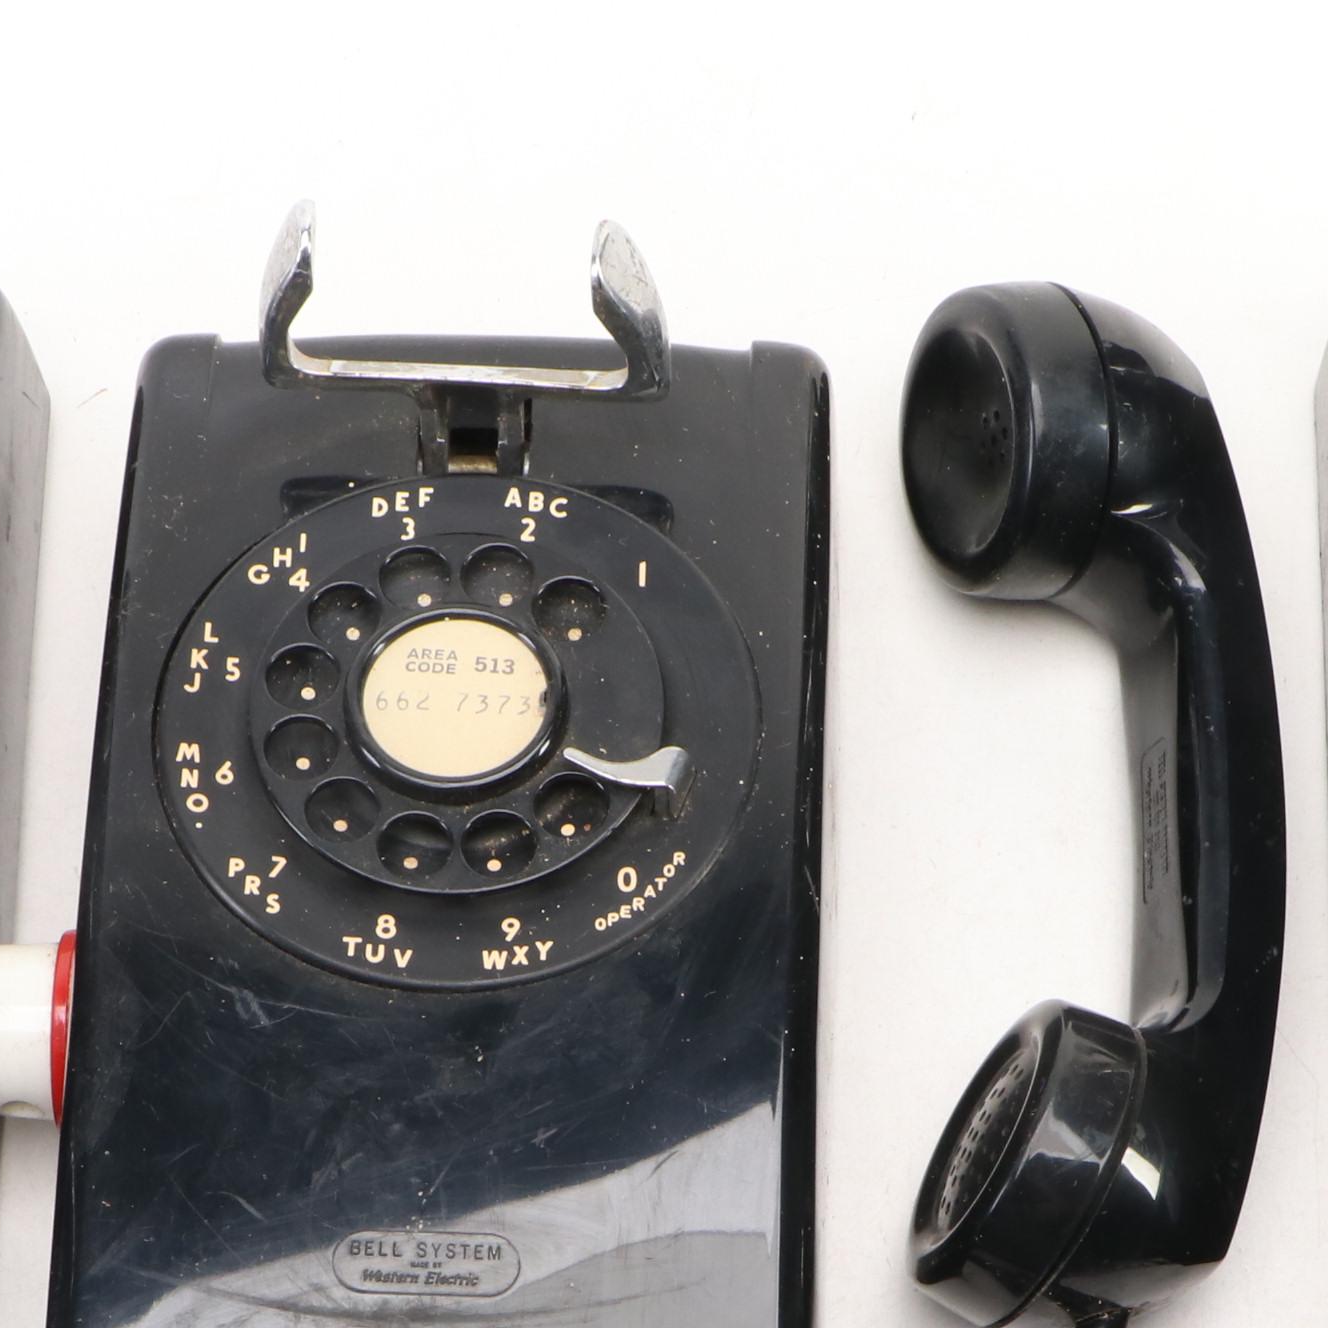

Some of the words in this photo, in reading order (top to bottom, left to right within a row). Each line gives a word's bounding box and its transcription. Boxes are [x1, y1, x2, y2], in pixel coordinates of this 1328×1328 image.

[371, 486, 435, 518] DEF
[503, 486, 569, 518] ABC
[400, 516, 416, 541] 3
[519, 517, 537, 543] 2
[248, 532, 309, 584] GHI
[287, 566, 310, 592] 4
[405, 661, 457, 675] CODE
[406, 648, 458, 662] AREA
[474, 656, 516, 675] 513
[224, 656, 241, 682] 5
[375, 690, 431, 711] 662
[455, 692, 532, 716] 7373
[214, 760, 235, 786] 6
[268, 855, 288, 879] 7
[227, 857, 281, 914] PRS
[594, 851, 686, 932] OPERATOR
[375, 914, 397, 940] 8
[500, 917, 521, 942] 9
[342, 935, 414, 969] TUV
[481, 939, 554, 971] WXY
[349, 1239, 403, 1257] BELL
[415, 1241, 503, 1261] SYSTEM
[362, 1268, 420, 1285] Western
[424, 1271, 480, 1287] Electric
